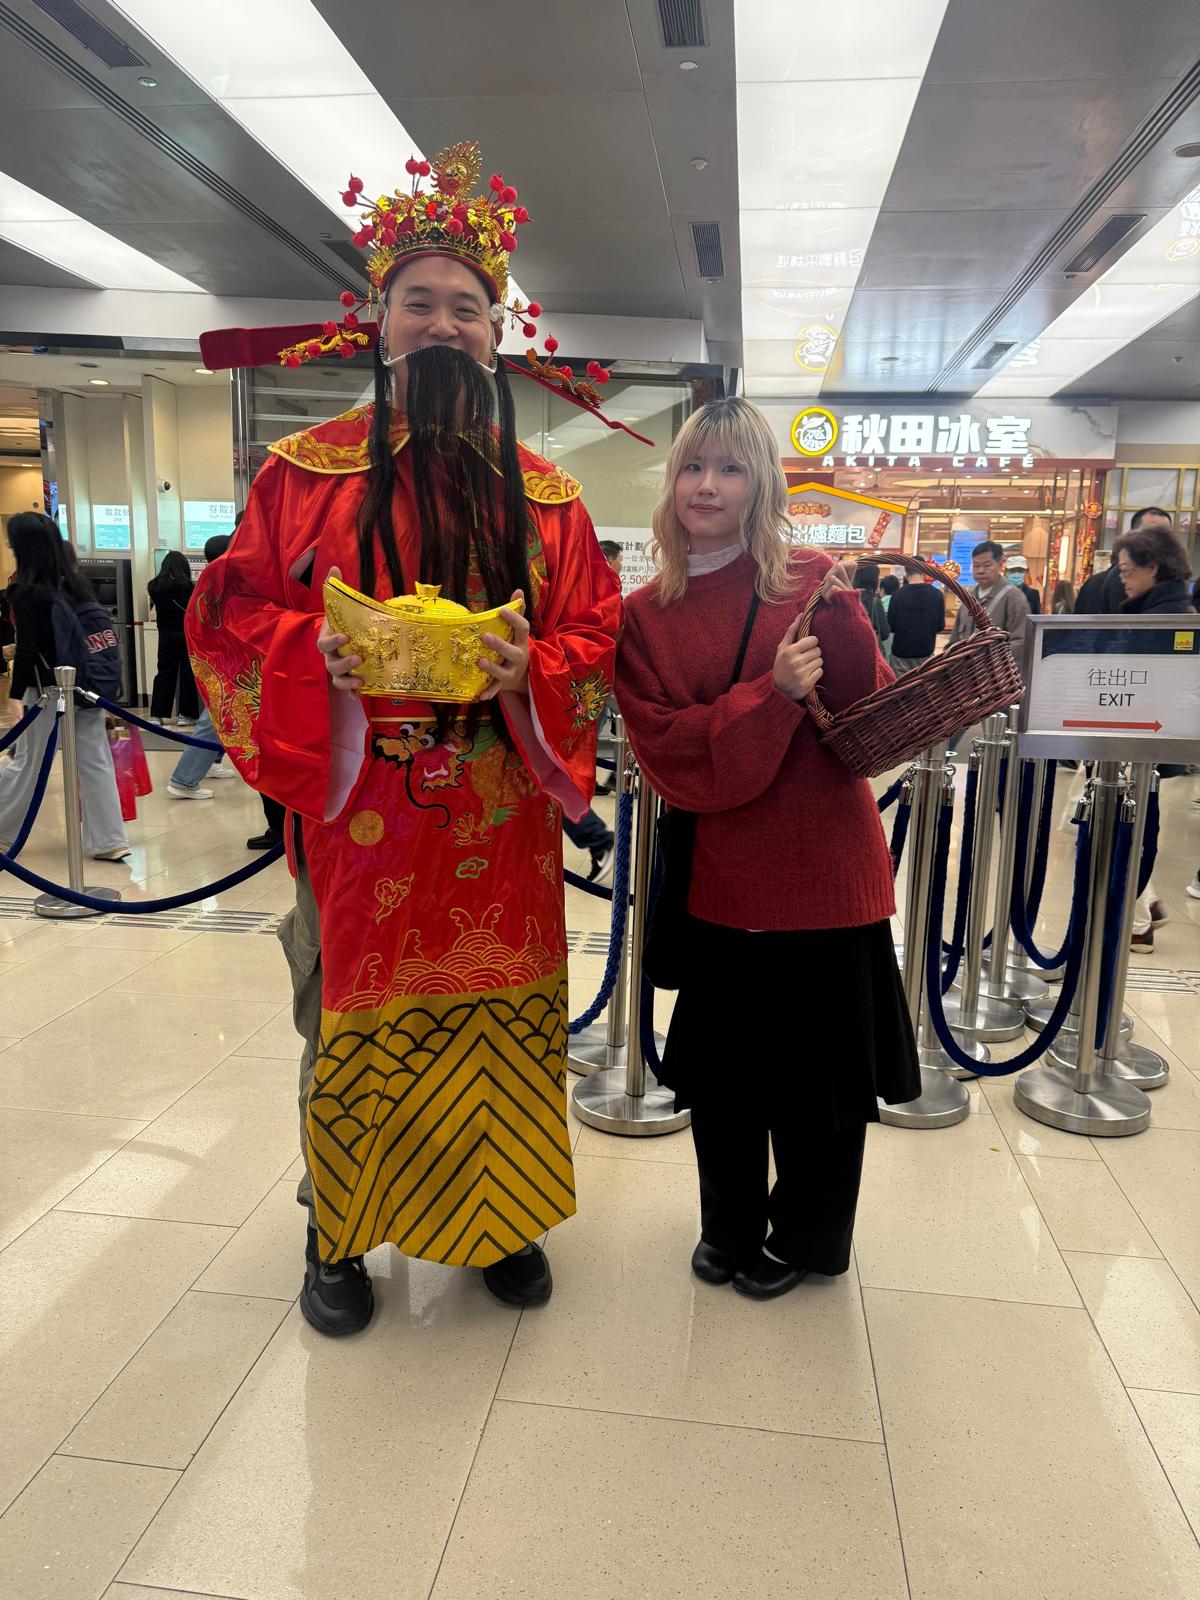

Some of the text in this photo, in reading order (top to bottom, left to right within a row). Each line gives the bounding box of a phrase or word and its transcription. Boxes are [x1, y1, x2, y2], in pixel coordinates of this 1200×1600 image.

[841, 414, 1032, 454] 秋田冰室
[822, 454, 1034, 468] AKITA CAFÉ
[780, 524, 866, 544] 出爐麵包
[1088, 668, 1148, 687] 往出口
[1099, 693, 1135, 707] EXIT
